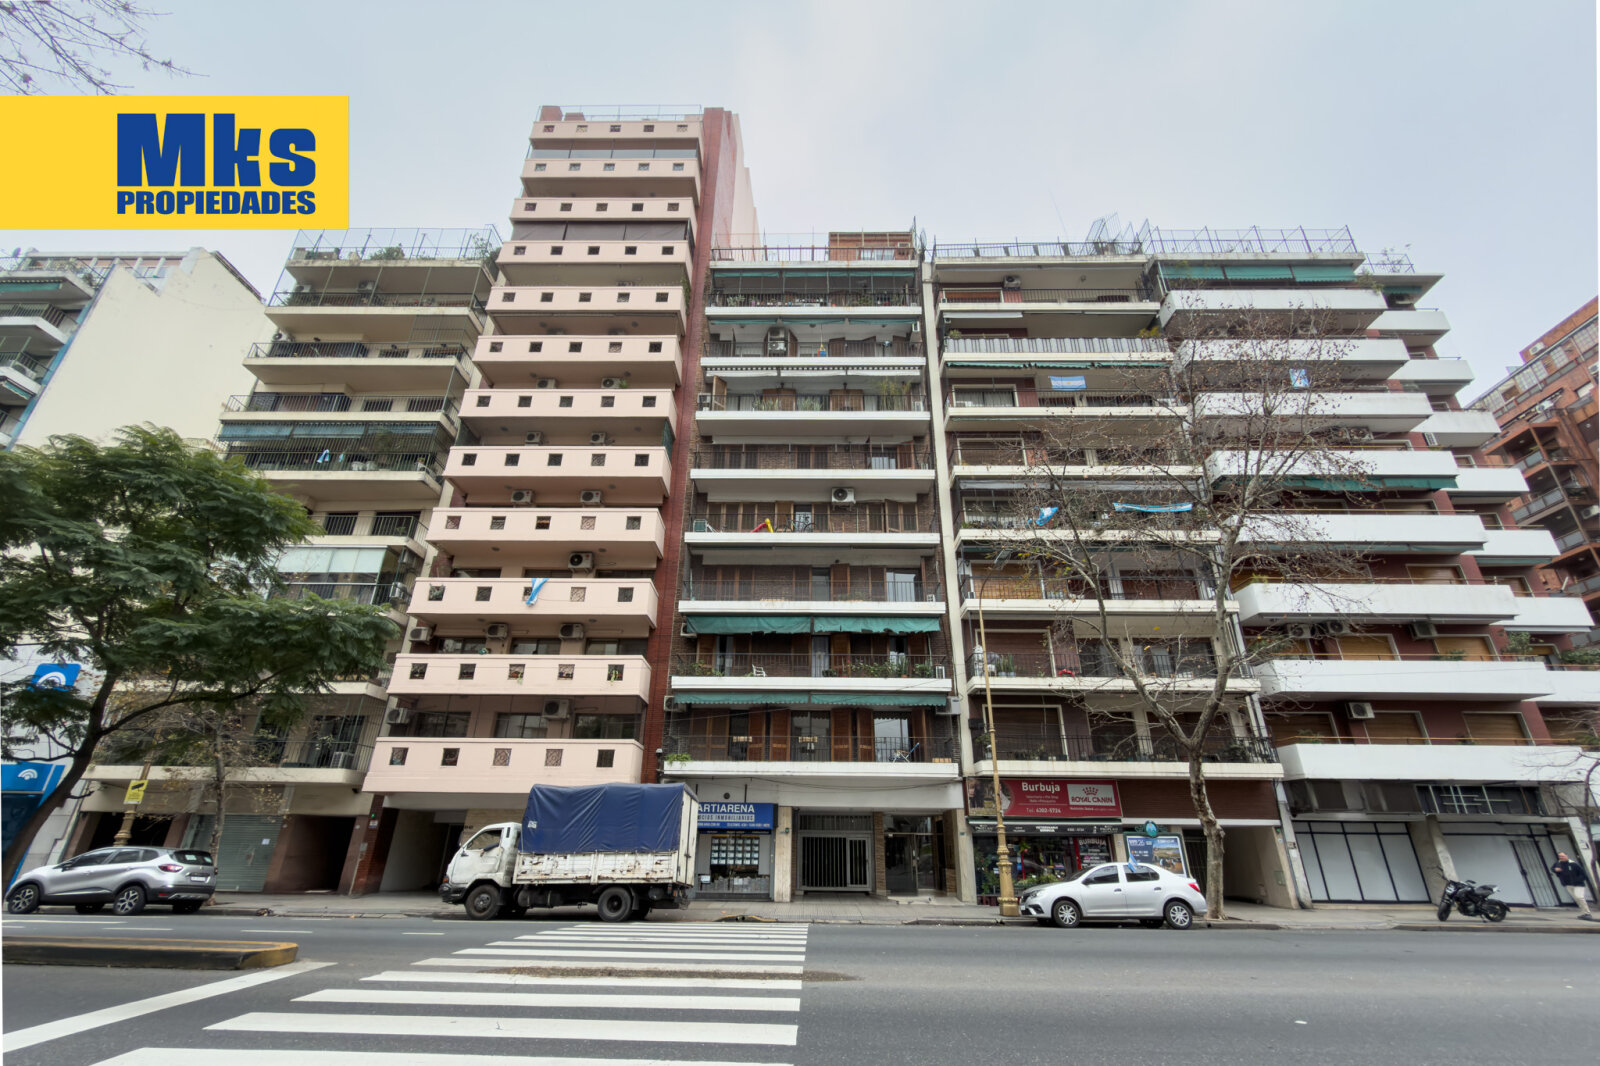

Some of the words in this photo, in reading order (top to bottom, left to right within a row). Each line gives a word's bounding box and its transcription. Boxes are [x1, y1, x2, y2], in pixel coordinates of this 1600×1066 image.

[1021, 781, 1061, 794] Burbuja
[1092, 796, 1114, 804] CANIN
[698, 803, 755, 813] ARTIARENA
